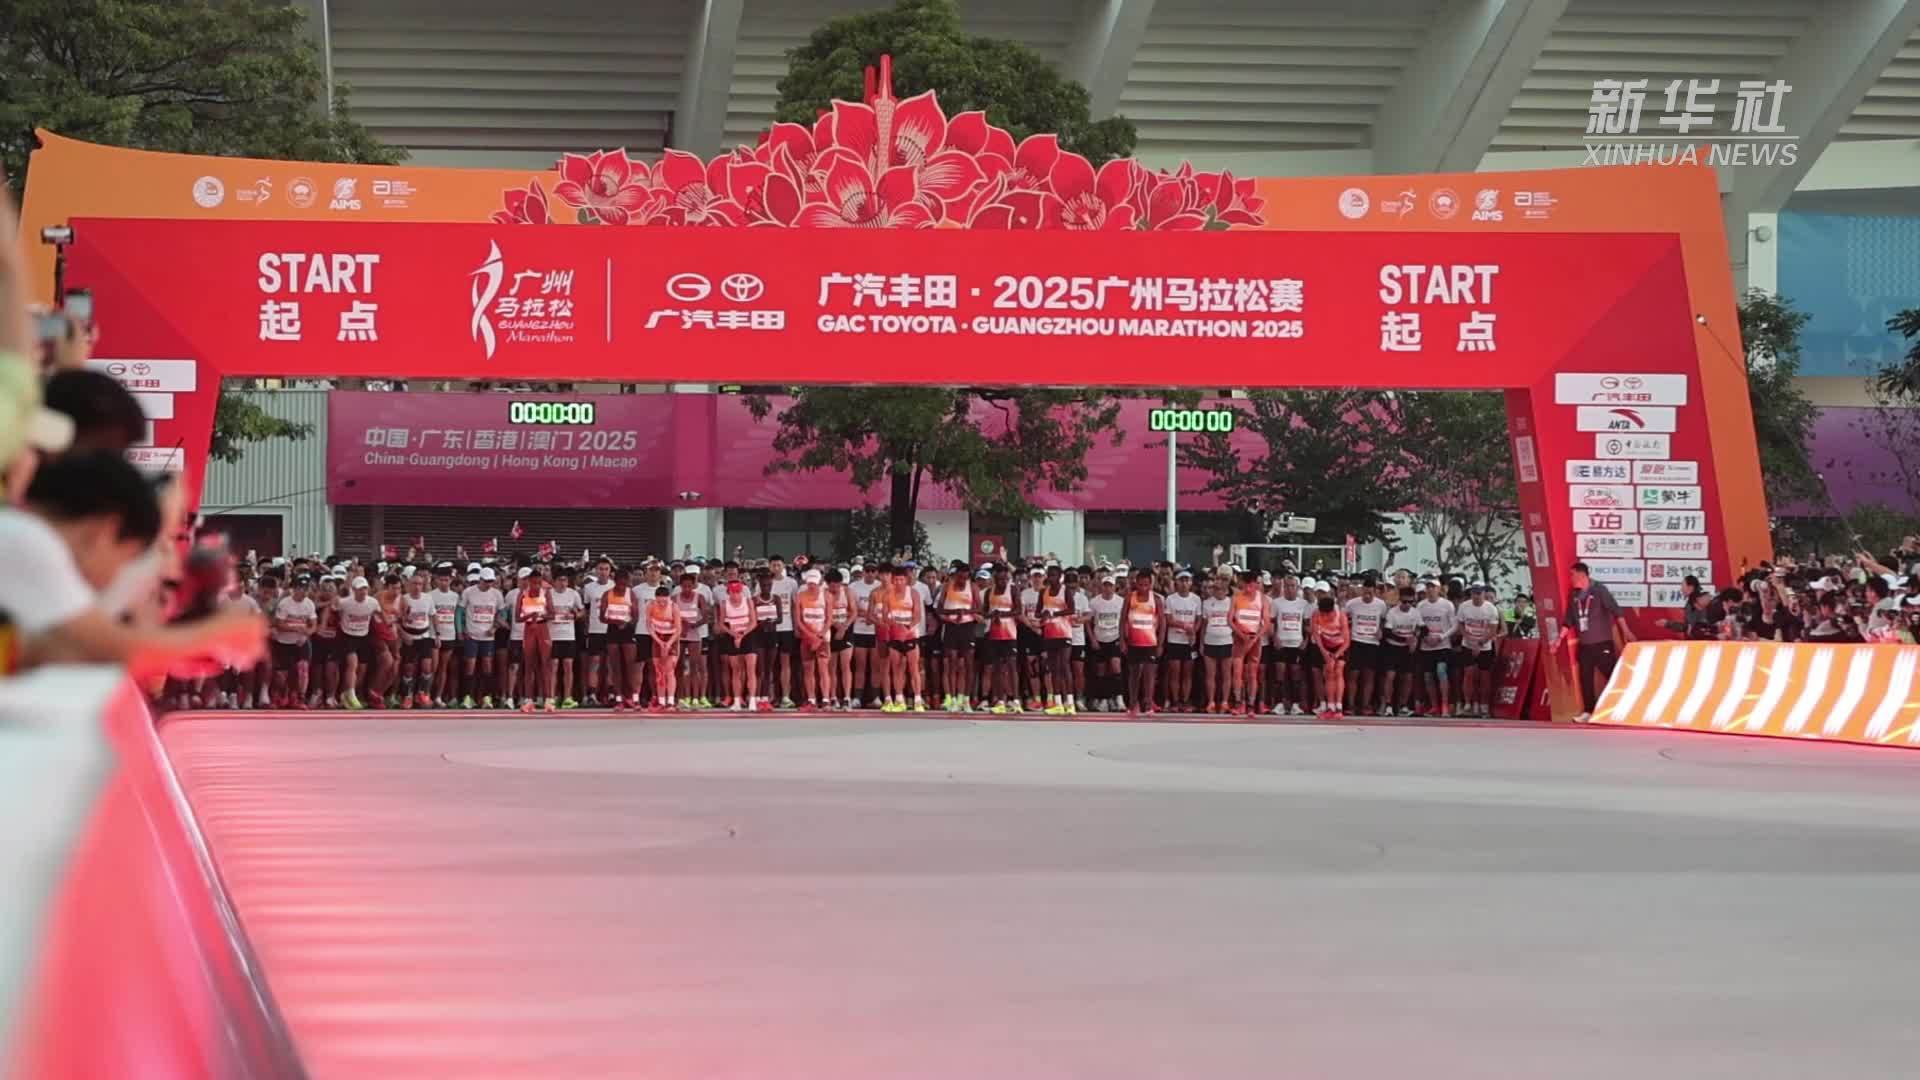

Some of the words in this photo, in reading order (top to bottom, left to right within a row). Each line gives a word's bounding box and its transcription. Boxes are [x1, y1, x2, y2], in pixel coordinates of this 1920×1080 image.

[329, 199, 361, 210] AIMS
[1472, 210, 1504, 221] AIMS
[258, 252, 380, 293] START
[509, 269, 574, 296] 广州
[1379, 264, 1499, 304] START
[495, 297, 574, 318] 马拉松
[498, 320, 575, 330] GUANGZHOU
[644, 309, 785, 330] 广汽丰田
[817, 314, 866, 334] GAC
[868, 314, 958, 334] TOYOTA
[971, 316, 1114, 336] GUANGZHOU
[1118, 318, 1247, 338] MARATHON
[1251, 320, 1304, 339] 2025
[506, 330, 575, 343] Marathon
[510, 402, 594, 424] 00:00:00
[1608, 419, 1631, 430] ANTA
[578, 430, 638, 451] 2025
[502, 453, 539, 470] Hong
[543, 455, 579, 470] Kong
[590, 455, 638, 469] Macao
[1588, 512, 1622, 529] 立白
